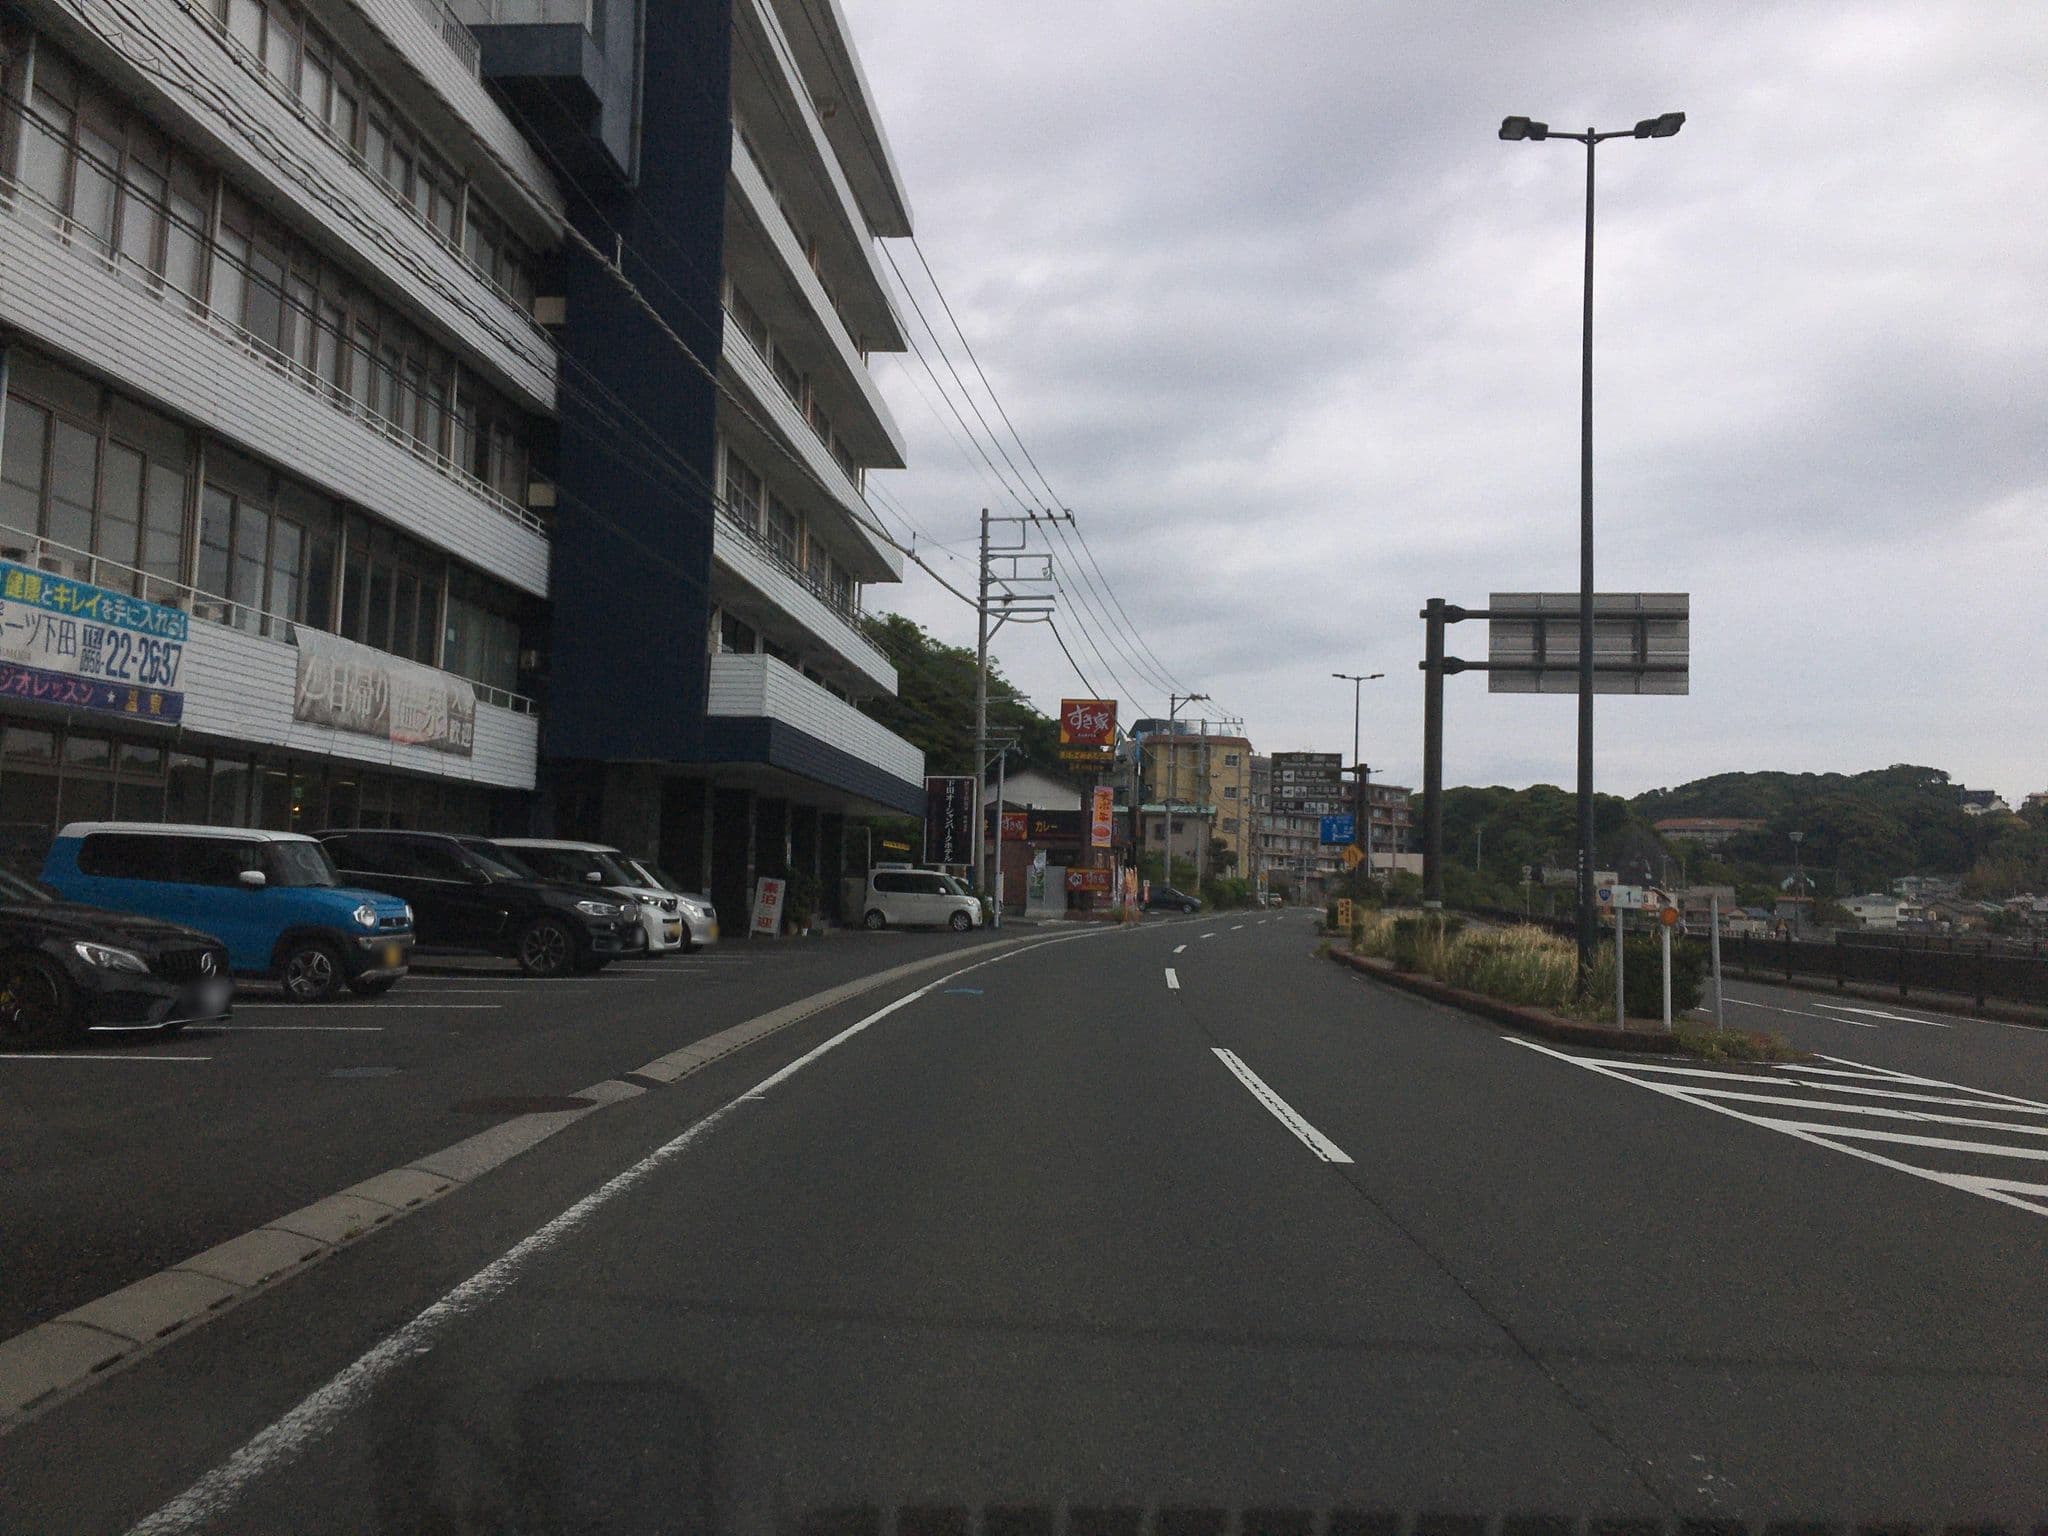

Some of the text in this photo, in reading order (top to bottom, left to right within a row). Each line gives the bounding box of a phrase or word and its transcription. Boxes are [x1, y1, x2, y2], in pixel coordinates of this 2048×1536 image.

[0, 612, 77, 658] ーツ下田
[1067, 704, 1109, 732] すき家
